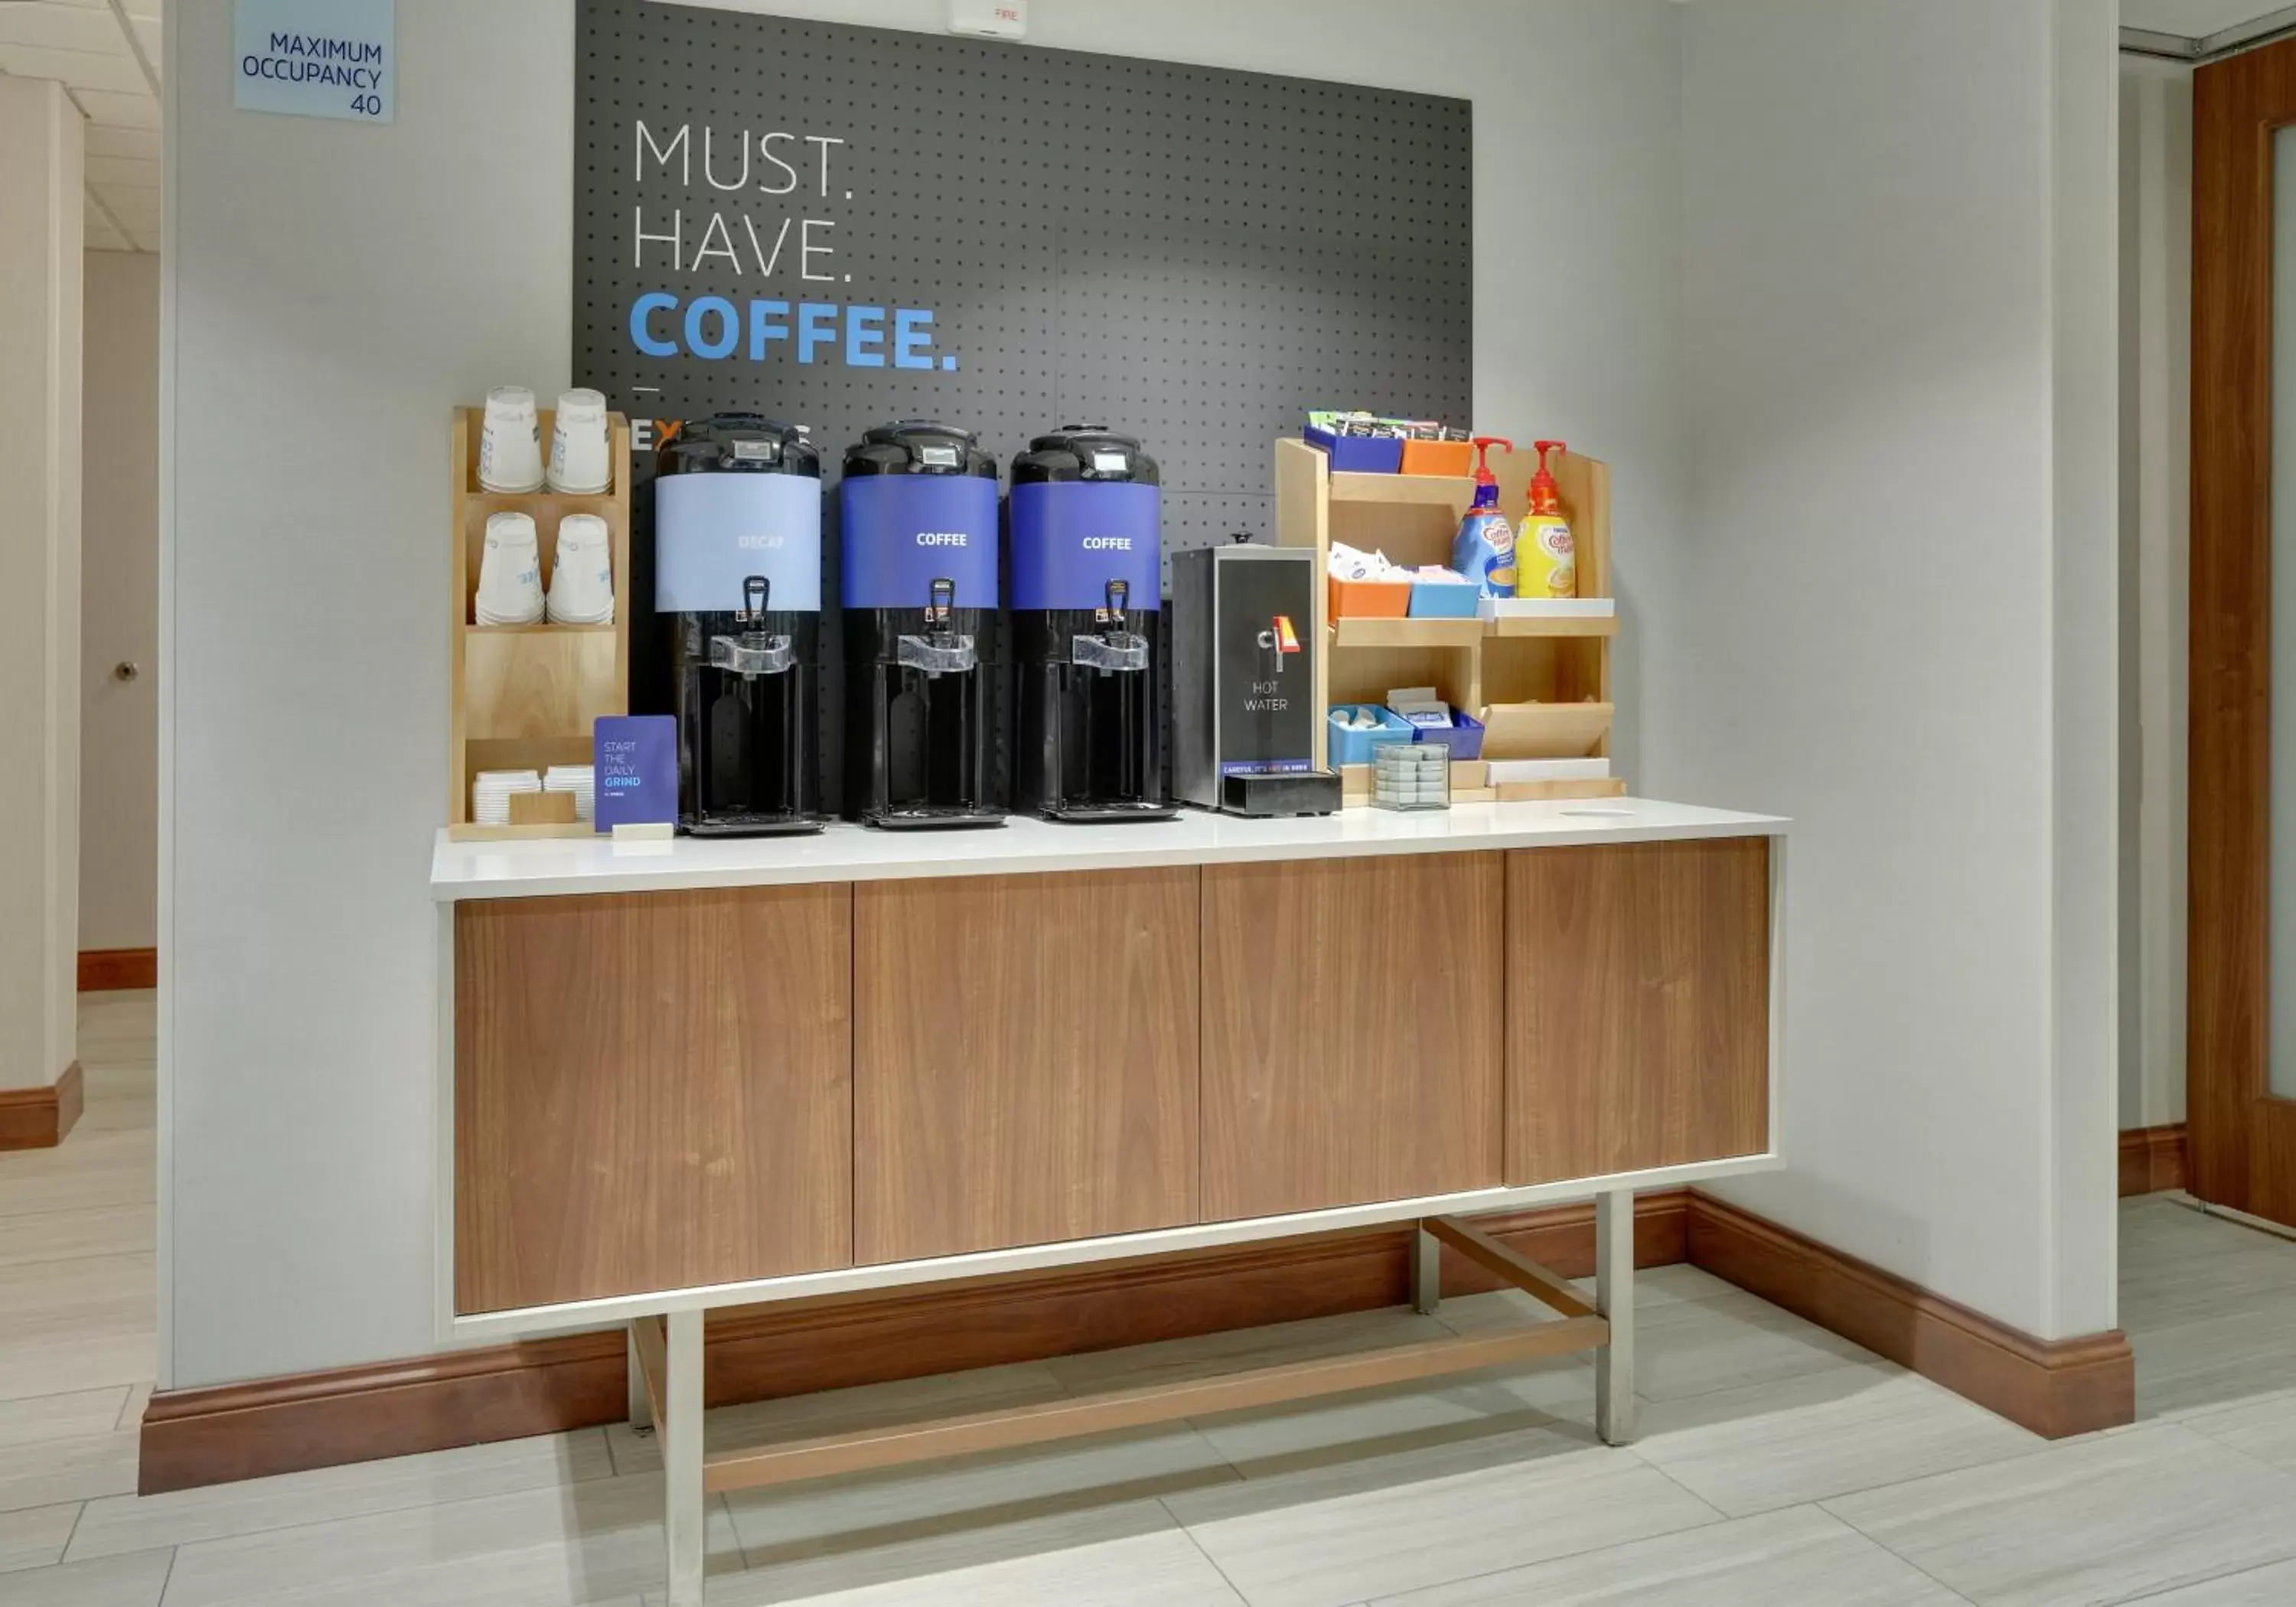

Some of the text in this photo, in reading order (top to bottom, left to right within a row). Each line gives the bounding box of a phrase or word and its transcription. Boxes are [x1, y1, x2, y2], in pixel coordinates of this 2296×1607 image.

[270, 31, 381, 64] MAXIMUM
[243, 56, 381, 90] OCCUPANCY
[351, 94, 381, 115] 40
[636, 120, 852, 199] MUST.
[634, 206, 851, 282] HAVE.
[629, 292, 956, 370] COFFEE.
[917, 533, 967, 546] COFFEE
[1083, 537, 1133, 550] COFFEE
[1252, 681, 1279, 694] HOT
[1244, 698, 1289, 711] WATER
[604, 742, 636, 752] START
[605, 754, 625, 764] THE
[605, 764, 636, 775] DAILY
[605, 777, 641, 787] GRIND
